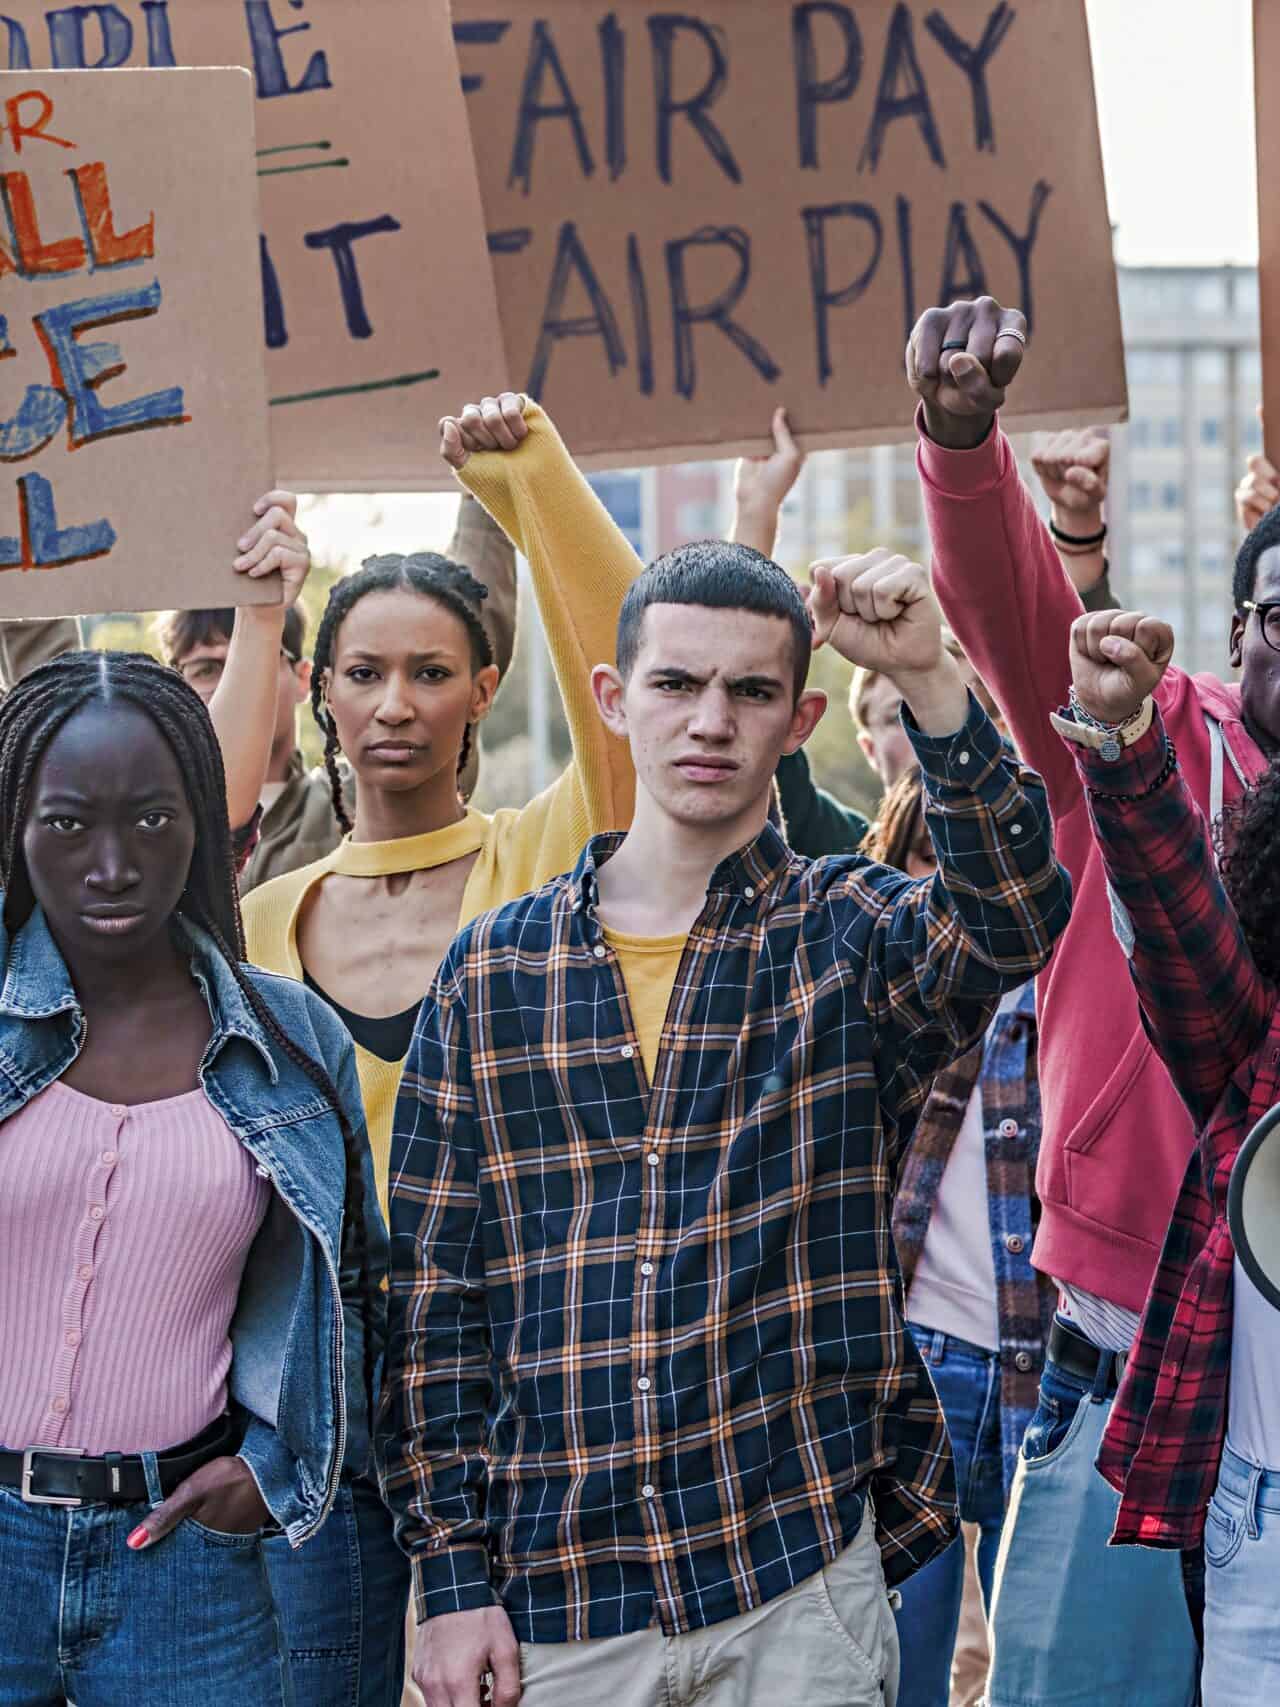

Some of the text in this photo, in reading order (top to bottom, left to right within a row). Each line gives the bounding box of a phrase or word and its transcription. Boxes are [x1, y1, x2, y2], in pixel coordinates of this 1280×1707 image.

[791, 0, 1017, 175] PAY
[0, 161, 155, 282] LL
[486, 220, 781, 403] AIR
